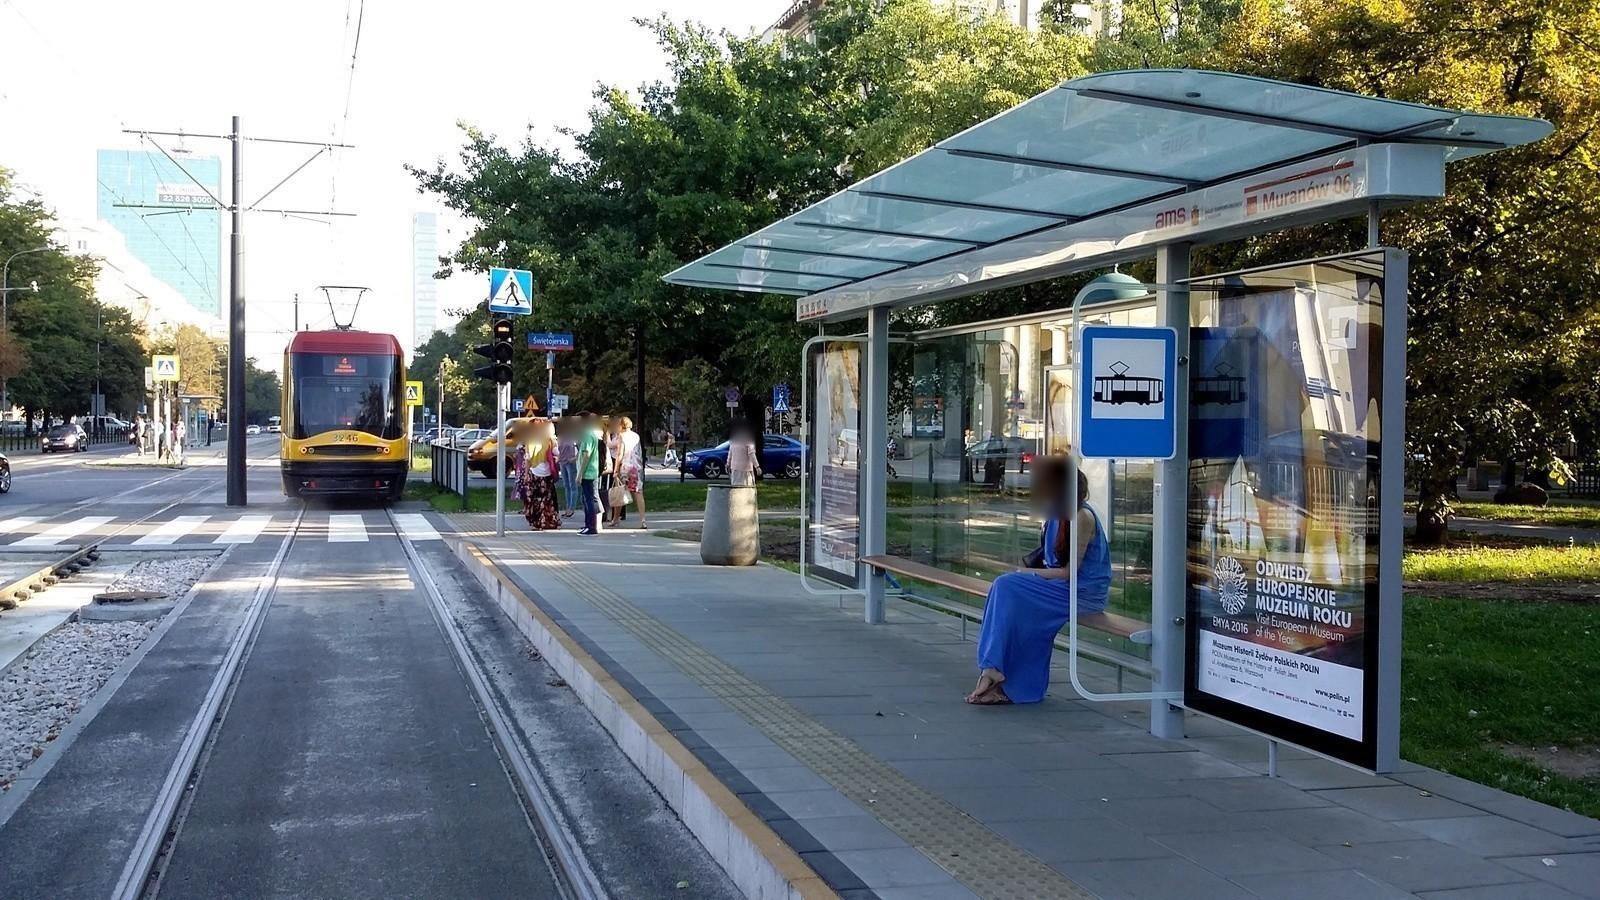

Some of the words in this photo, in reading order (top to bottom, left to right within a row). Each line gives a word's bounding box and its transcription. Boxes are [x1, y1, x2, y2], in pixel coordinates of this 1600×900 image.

[1263, 181, 1330, 210] Muranów
[1334, 173, 1352, 195] 06
[1156, 207, 1186, 229] ams
[533, 335, 569, 346] Świętojerska
[516, 400, 523, 411] P
[335, 434, 358, 442] 3246
[1256, 577, 1336, 606] EUROPEJSKIE
[1256, 595, 1310, 620] MUZEUM
[1313, 607, 1352, 628] ROKU
[1213, 616, 1230, 630] EMYA
[1231, 621, 1249, 634] 2016
[1256, 612, 1270, 625] Visit
[1272, 616, 1307, 633] European
[1310, 624, 1344, 642] Museum
[1256, 626, 1263, 637] of
[1264, 628, 1276, 640] the
[1278, 630, 1296, 645] Year
[1213, 639, 1233, 651] Muzeum
[1234, 645, 1254, 656] Historii
[1255, 648, 1273, 661] Żydów
[1274, 656, 1299, 669] Polskich
[1300, 662, 1320, 674] POLIN
[1314, 689, 1350, 703] www.polin.pl
